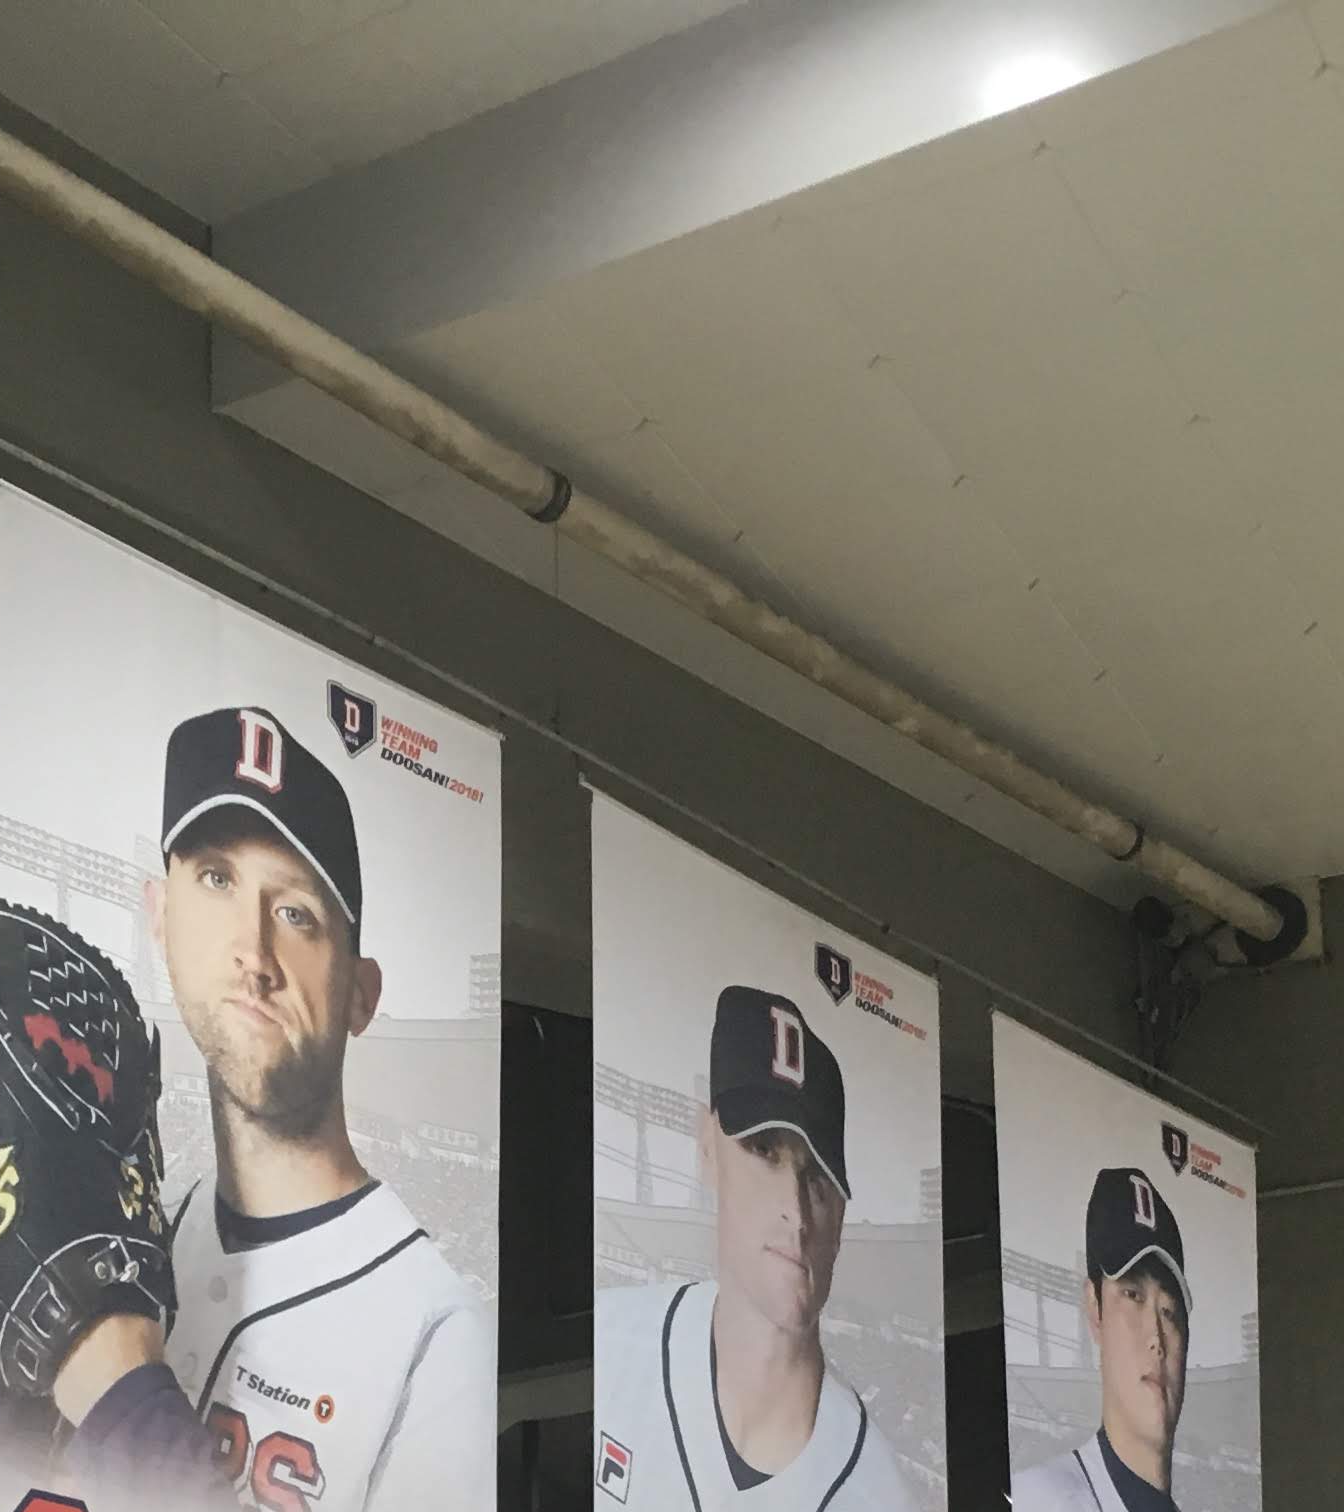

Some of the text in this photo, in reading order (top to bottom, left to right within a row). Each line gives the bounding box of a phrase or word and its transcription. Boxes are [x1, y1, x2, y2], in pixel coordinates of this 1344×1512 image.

[381, 715, 439, 754] WINNING
[381, 731, 422, 761] TEAM
[855, 984, 885, 1007] TEAM
